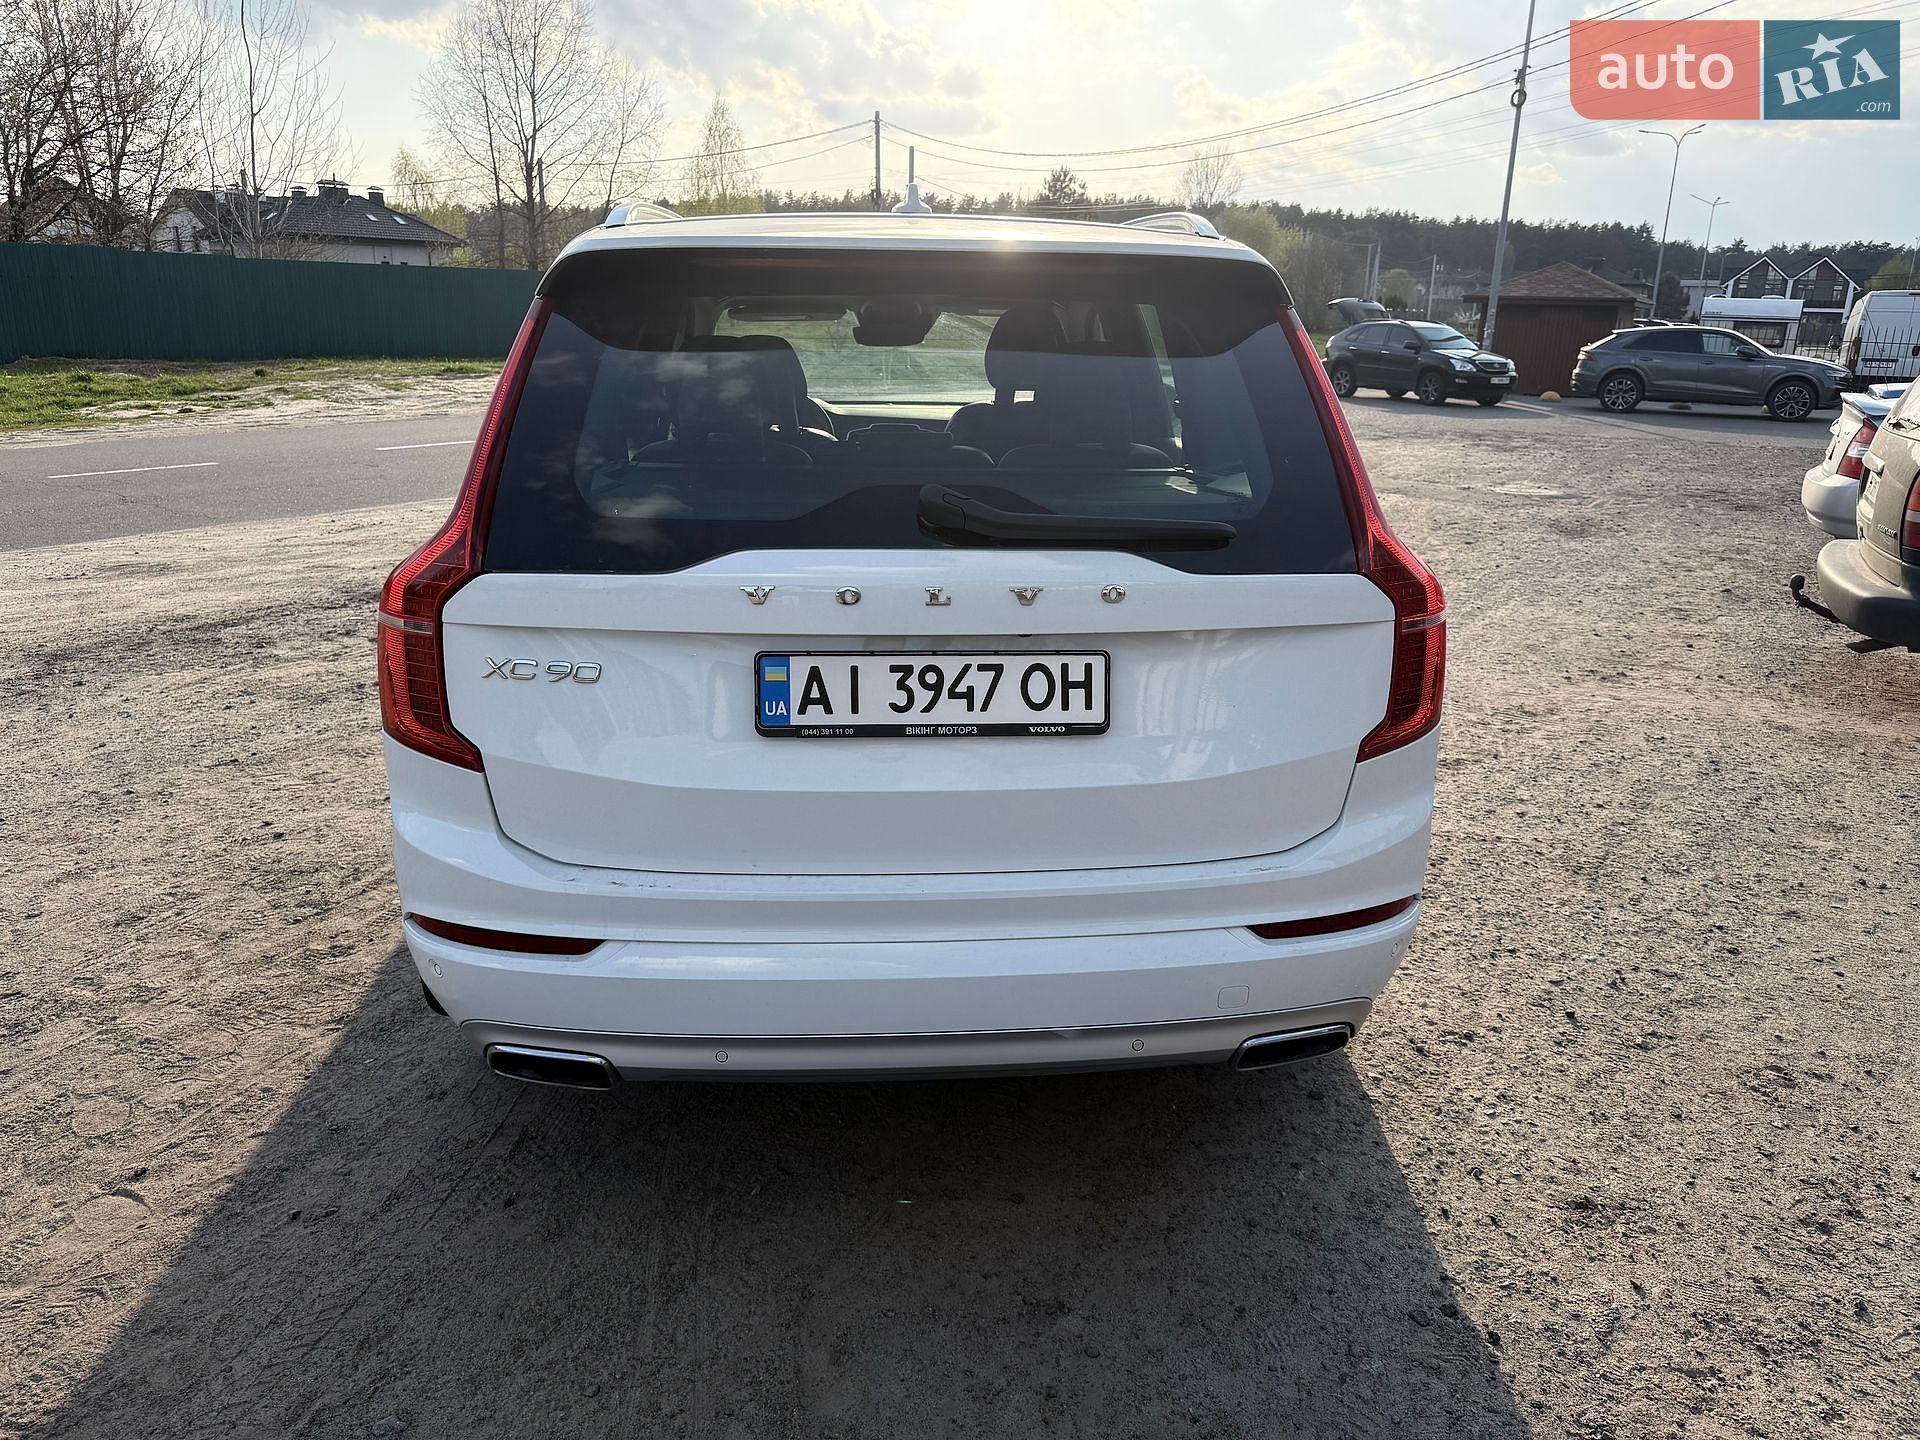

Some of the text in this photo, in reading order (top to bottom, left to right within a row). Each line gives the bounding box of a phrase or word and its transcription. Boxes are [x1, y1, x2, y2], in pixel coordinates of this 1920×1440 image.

[739, 584, 1126, 606] VOLVO
[481, 657, 602, 683] XC 90
[797, 662, 1093, 715] AI 3947 OH
[765, 701, 787, 716] UA
[801, 728, 820, 736] (044)
[906, 726, 978, 735] ВІКІНГ МОТОРЗ
